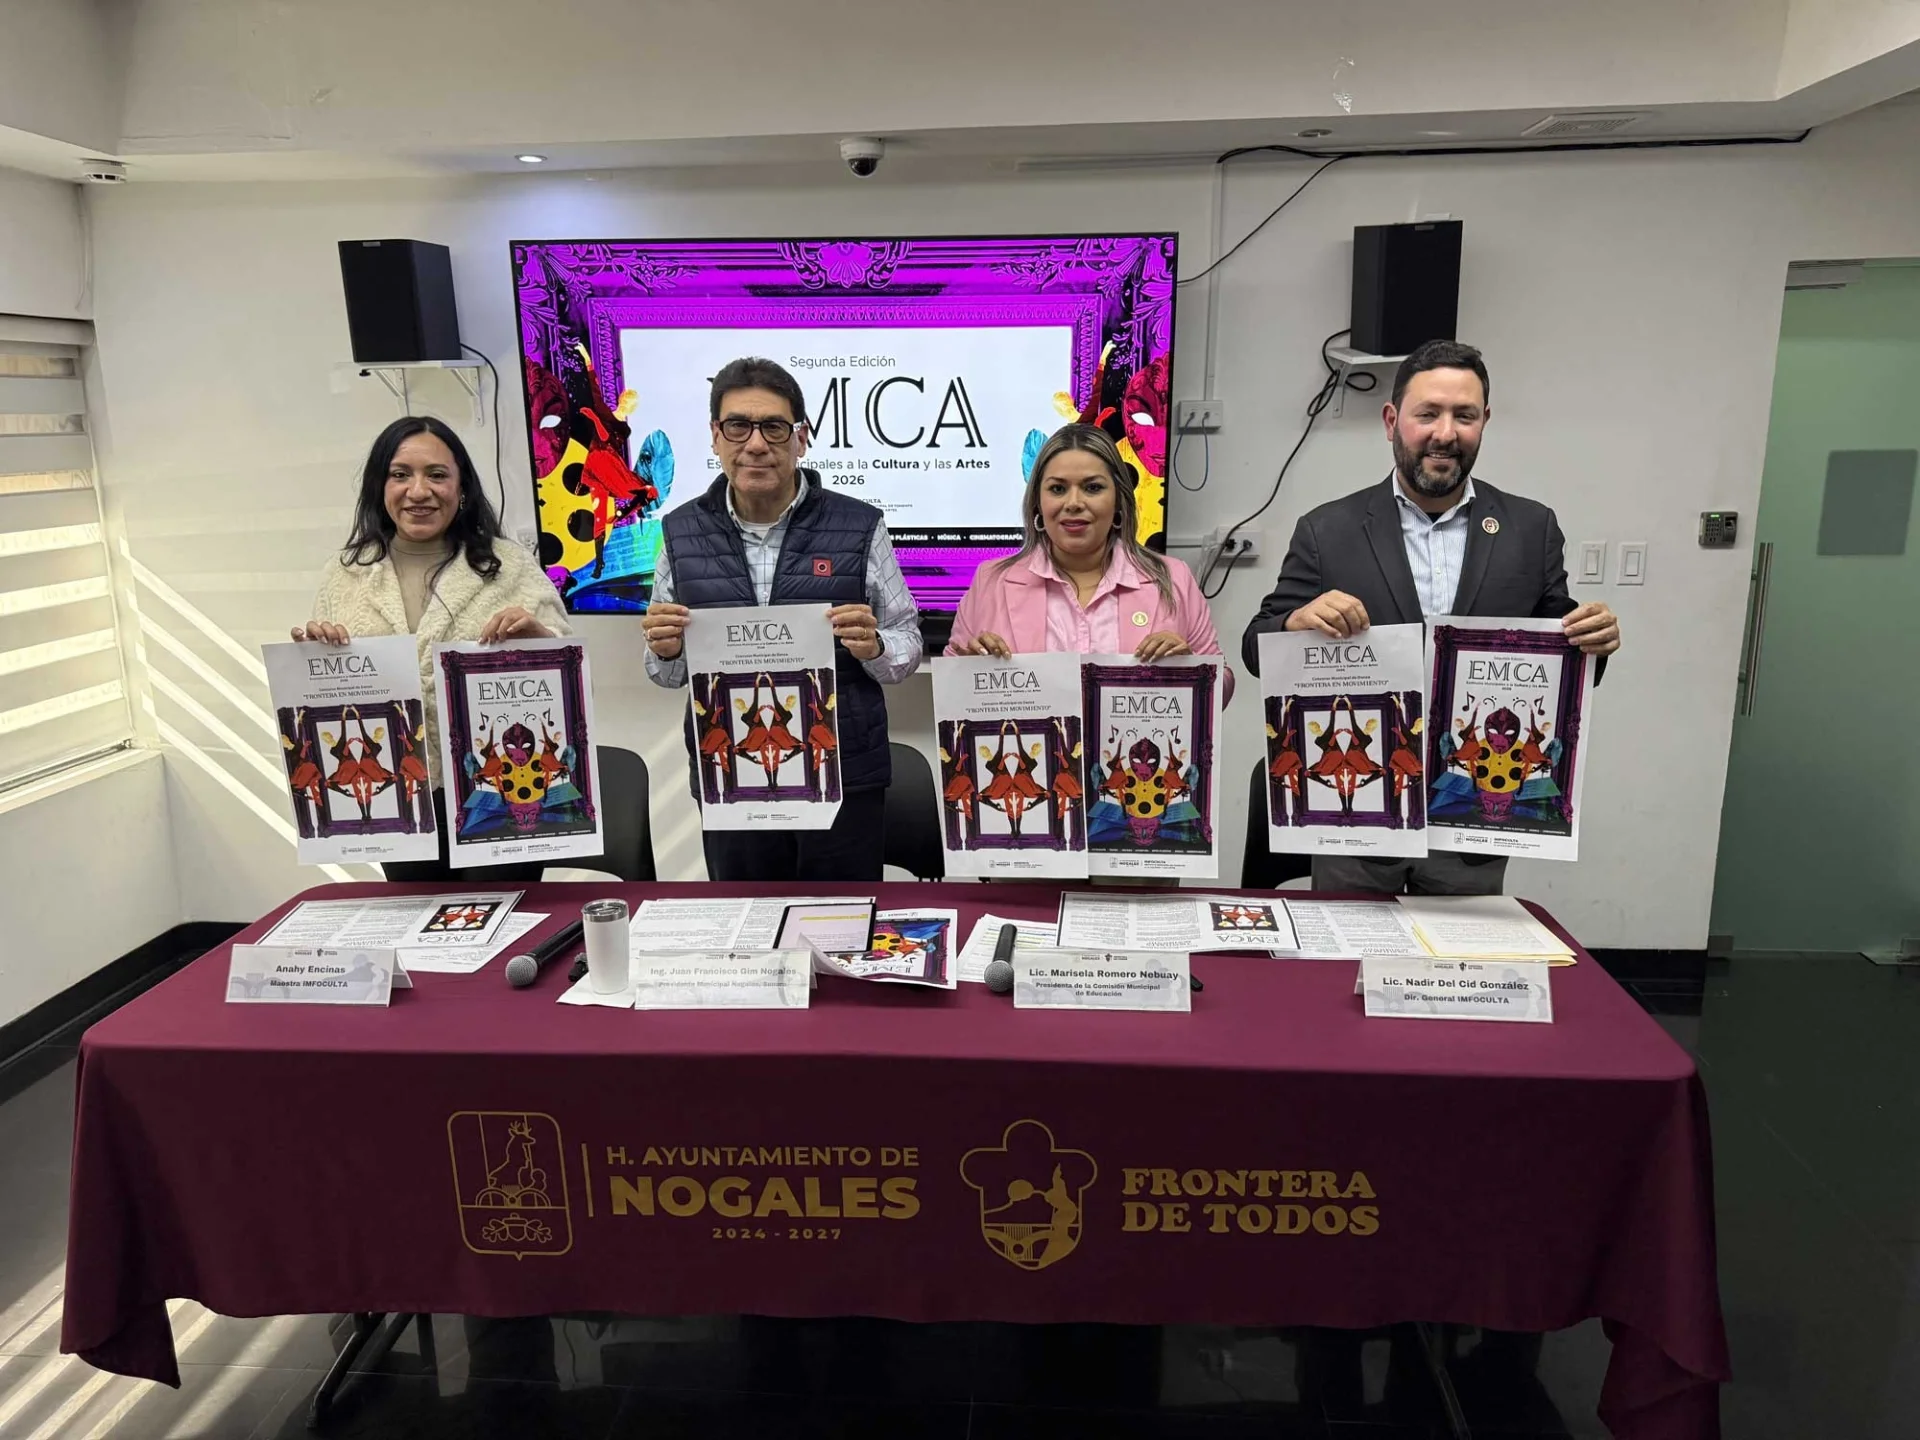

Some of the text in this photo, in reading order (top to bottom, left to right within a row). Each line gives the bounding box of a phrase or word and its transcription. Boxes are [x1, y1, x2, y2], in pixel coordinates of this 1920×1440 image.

[790, 355, 895, 368] Segunda Edición
[707, 376, 988, 448] MCA
[847, 461, 854, 469] a
[858, 459, 868, 469] la
[872, 459, 919, 469] Cultura
[923, 461, 930, 471] y
[934, 459, 952, 469] las
[955, 459, 990, 469] Artes
[832, 475, 865, 485] 2026
[726, 622, 793, 642] EMCA
[1304, 645, 1377, 665] EMCA
[308, 655, 376, 676] EMCA
[1468, 660, 1549, 683] EMCA
[478, 679, 552, 700] EMCA
[973, 671, 1040, 690] EMCA
[1111, 696, 1182, 714] EMCA
[276, 965, 346, 974] Anahy Encinas
[650, 967, 796, 977] Ing. Juan Francisco Gim Nogales
[1029, 969, 1178, 980] Lic. Marisela Romero Nebuay
[1383, 977, 1529, 990] Lic. Nadir Del Cid González
[1422, 994, 1455, 1002] General
[1457, 995, 1509, 1004] IMFOCULTA
[606, 1146, 920, 1166] H. AYUNTAMIENTO DE
[1121, 1168, 1377, 1199] FRONTERA
[609, 1175, 921, 1220] NOGALES
[1121, 1202, 1380, 1236] DE TODOS
[712, 1228, 766, 1239] 2024
[788, 1228, 841, 1239] 2027
